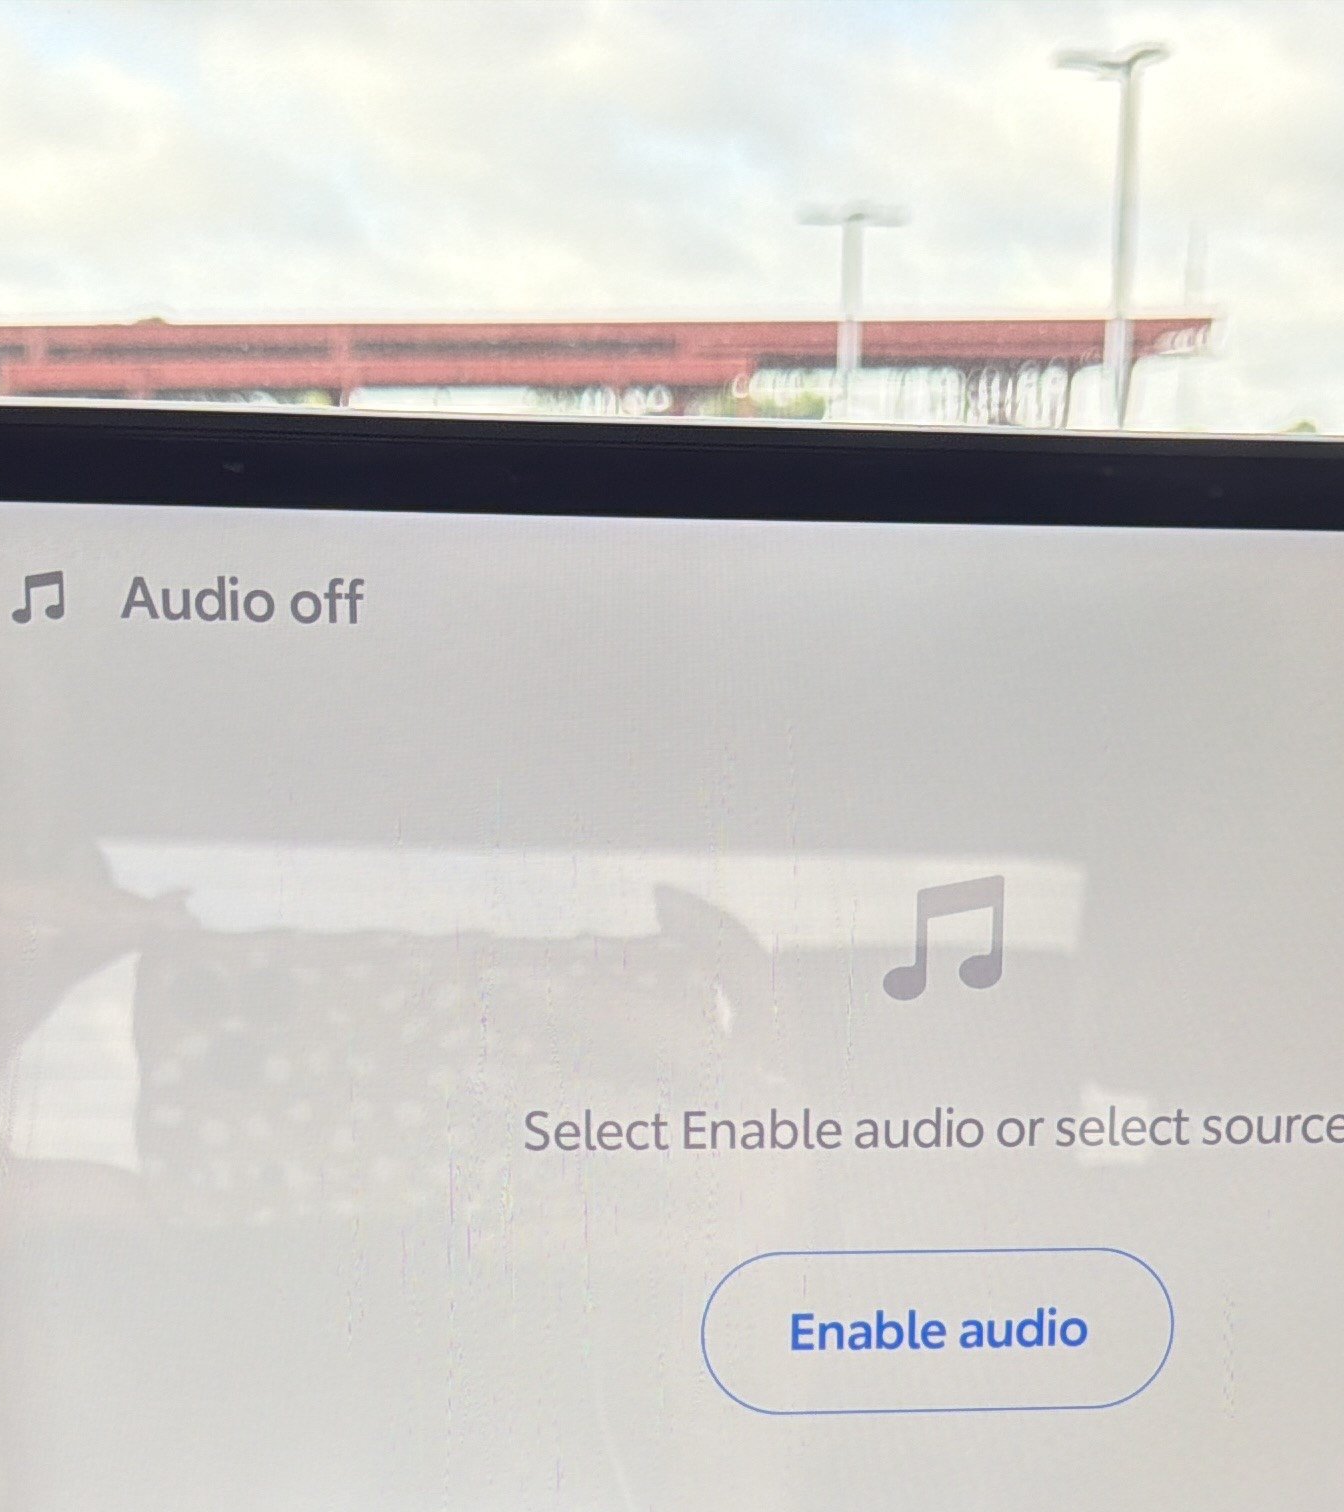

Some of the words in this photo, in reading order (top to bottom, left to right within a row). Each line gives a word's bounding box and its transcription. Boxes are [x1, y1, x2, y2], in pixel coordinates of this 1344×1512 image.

[120, 574, 276, 624] Audio
[289, 577, 365, 626] off
[522, 1107, 670, 1153] Select
[681, 1109, 844, 1152] Enable
[854, 1106, 986, 1151] audio
[996, 1113, 1045, 1149] or
[1055, 1105, 1192, 1149] select
[789, 1310, 949, 1353] Enable
[959, 1307, 1090, 1352] audio
